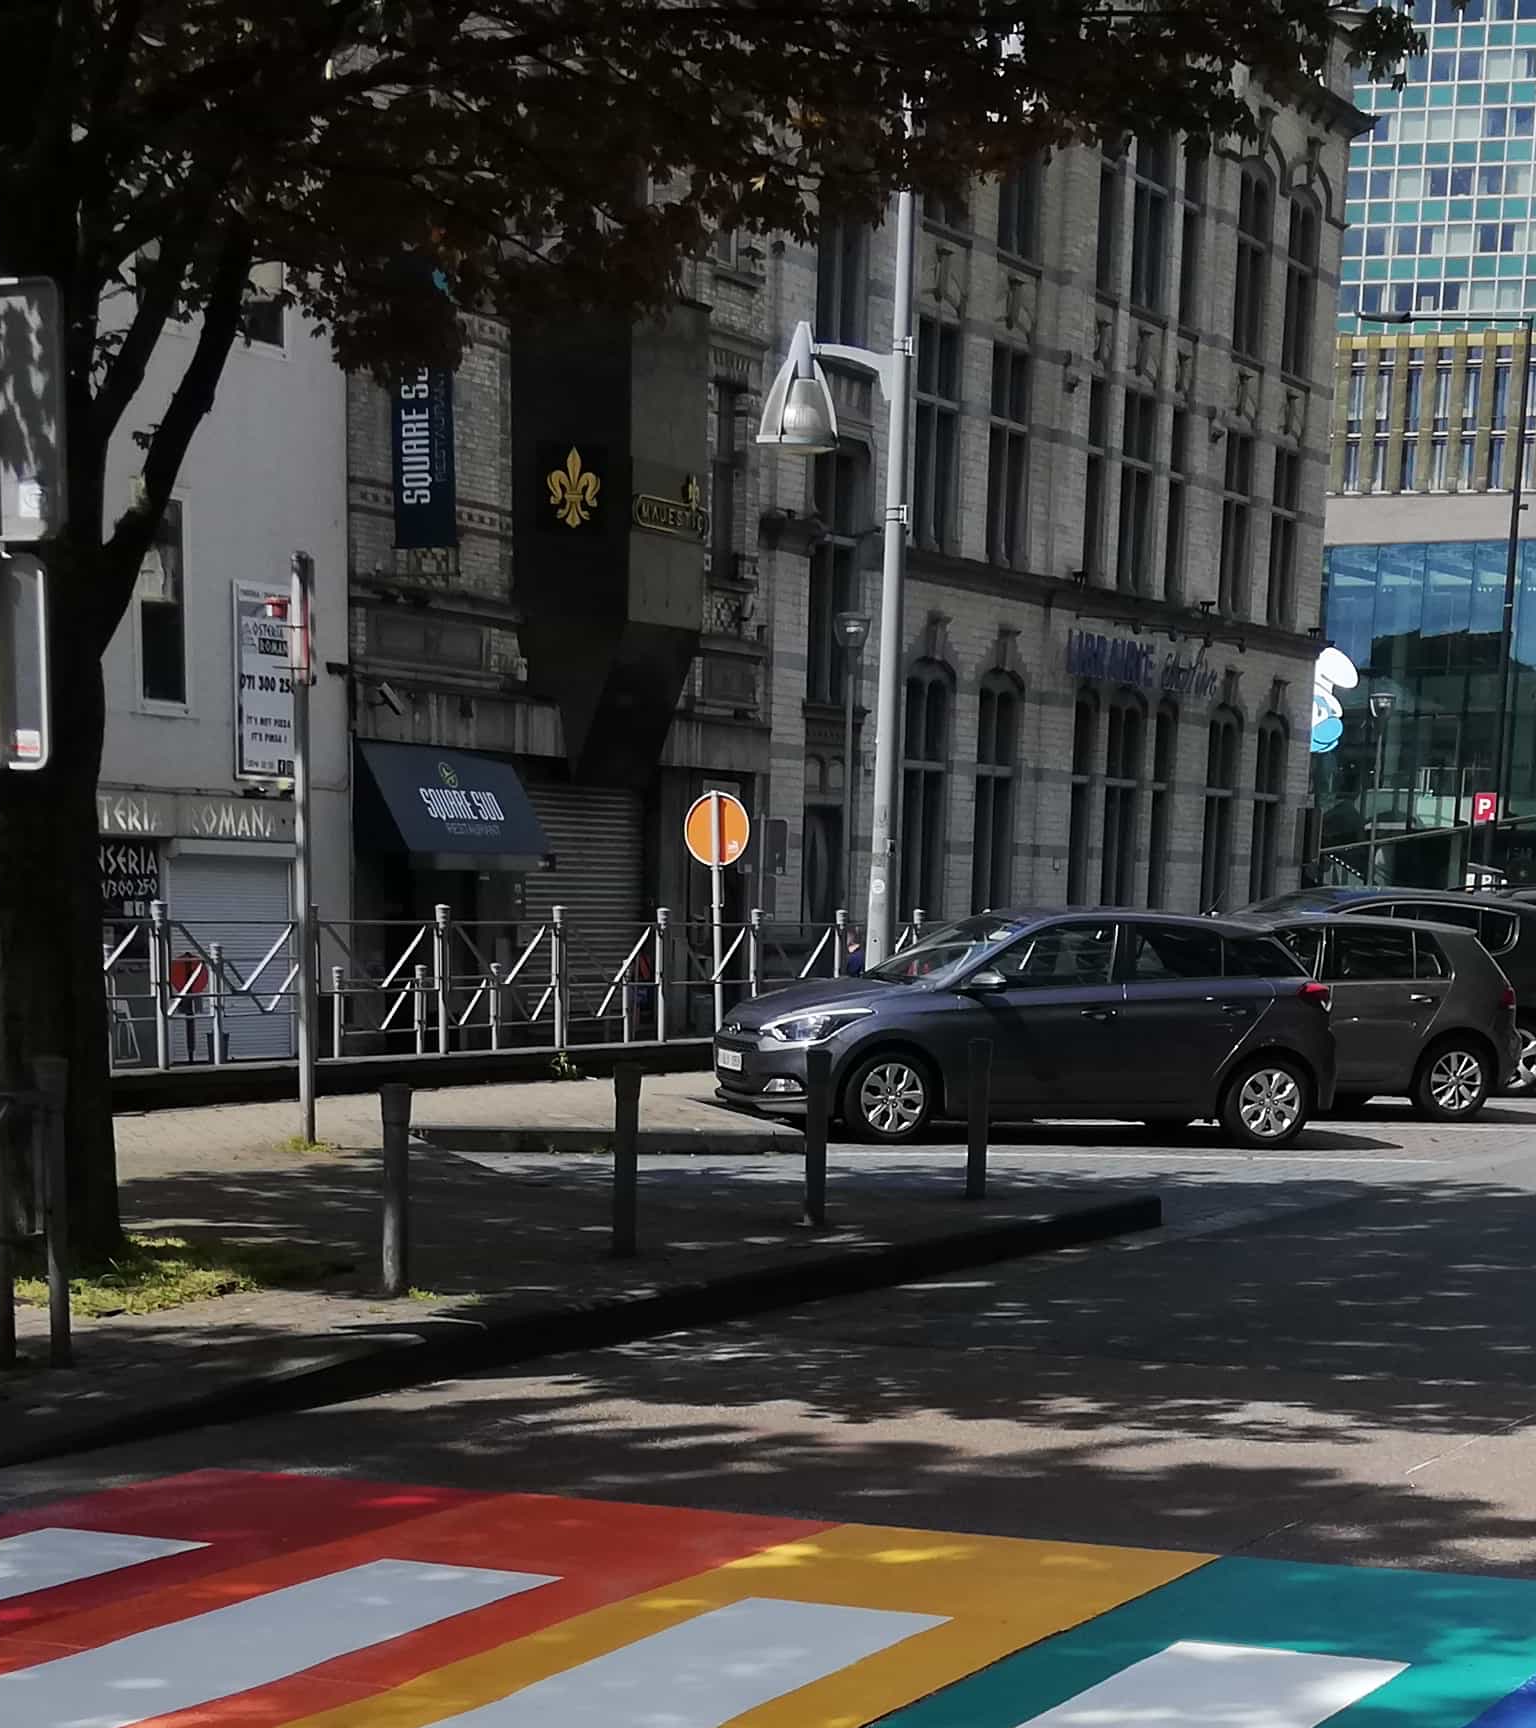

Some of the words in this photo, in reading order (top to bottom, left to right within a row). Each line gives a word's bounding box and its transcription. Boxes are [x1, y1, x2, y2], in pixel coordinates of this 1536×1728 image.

[401, 407, 432, 505] SQUARE
[259, 675, 276, 691] 300
[419, 787, 478, 821] SQUARE
[470, 790, 505, 821] SUD
